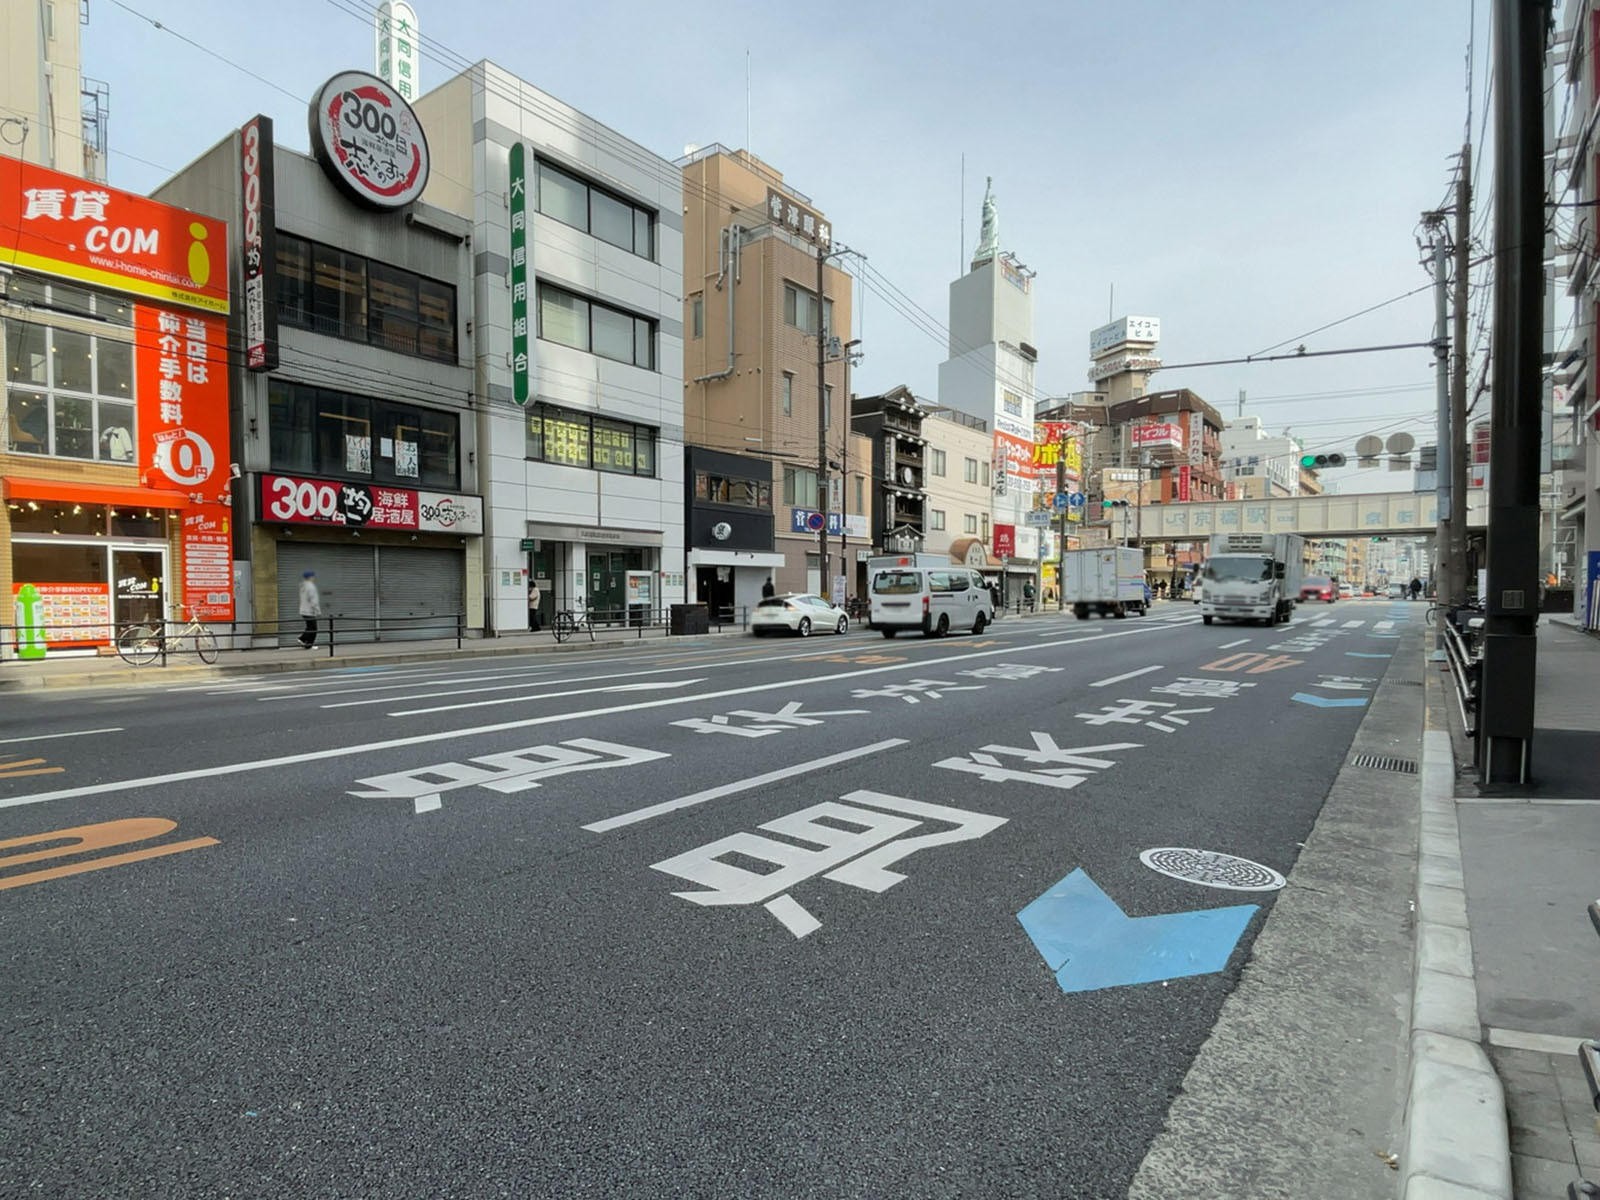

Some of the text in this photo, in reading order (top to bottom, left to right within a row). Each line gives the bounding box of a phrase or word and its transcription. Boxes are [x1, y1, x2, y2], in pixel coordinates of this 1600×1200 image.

[23, 188, 110, 221] 賃貸
[511, 177, 527, 372] 大同信用組合
[1135, 329, 1153, 338] ビル
[186, 318, 209, 384] 当店は
[158, 311, 182, 425] 仲介手数料
[378, 491, 409, 508] 海鮮
[371, 508, 416, 525] 居酒屋
